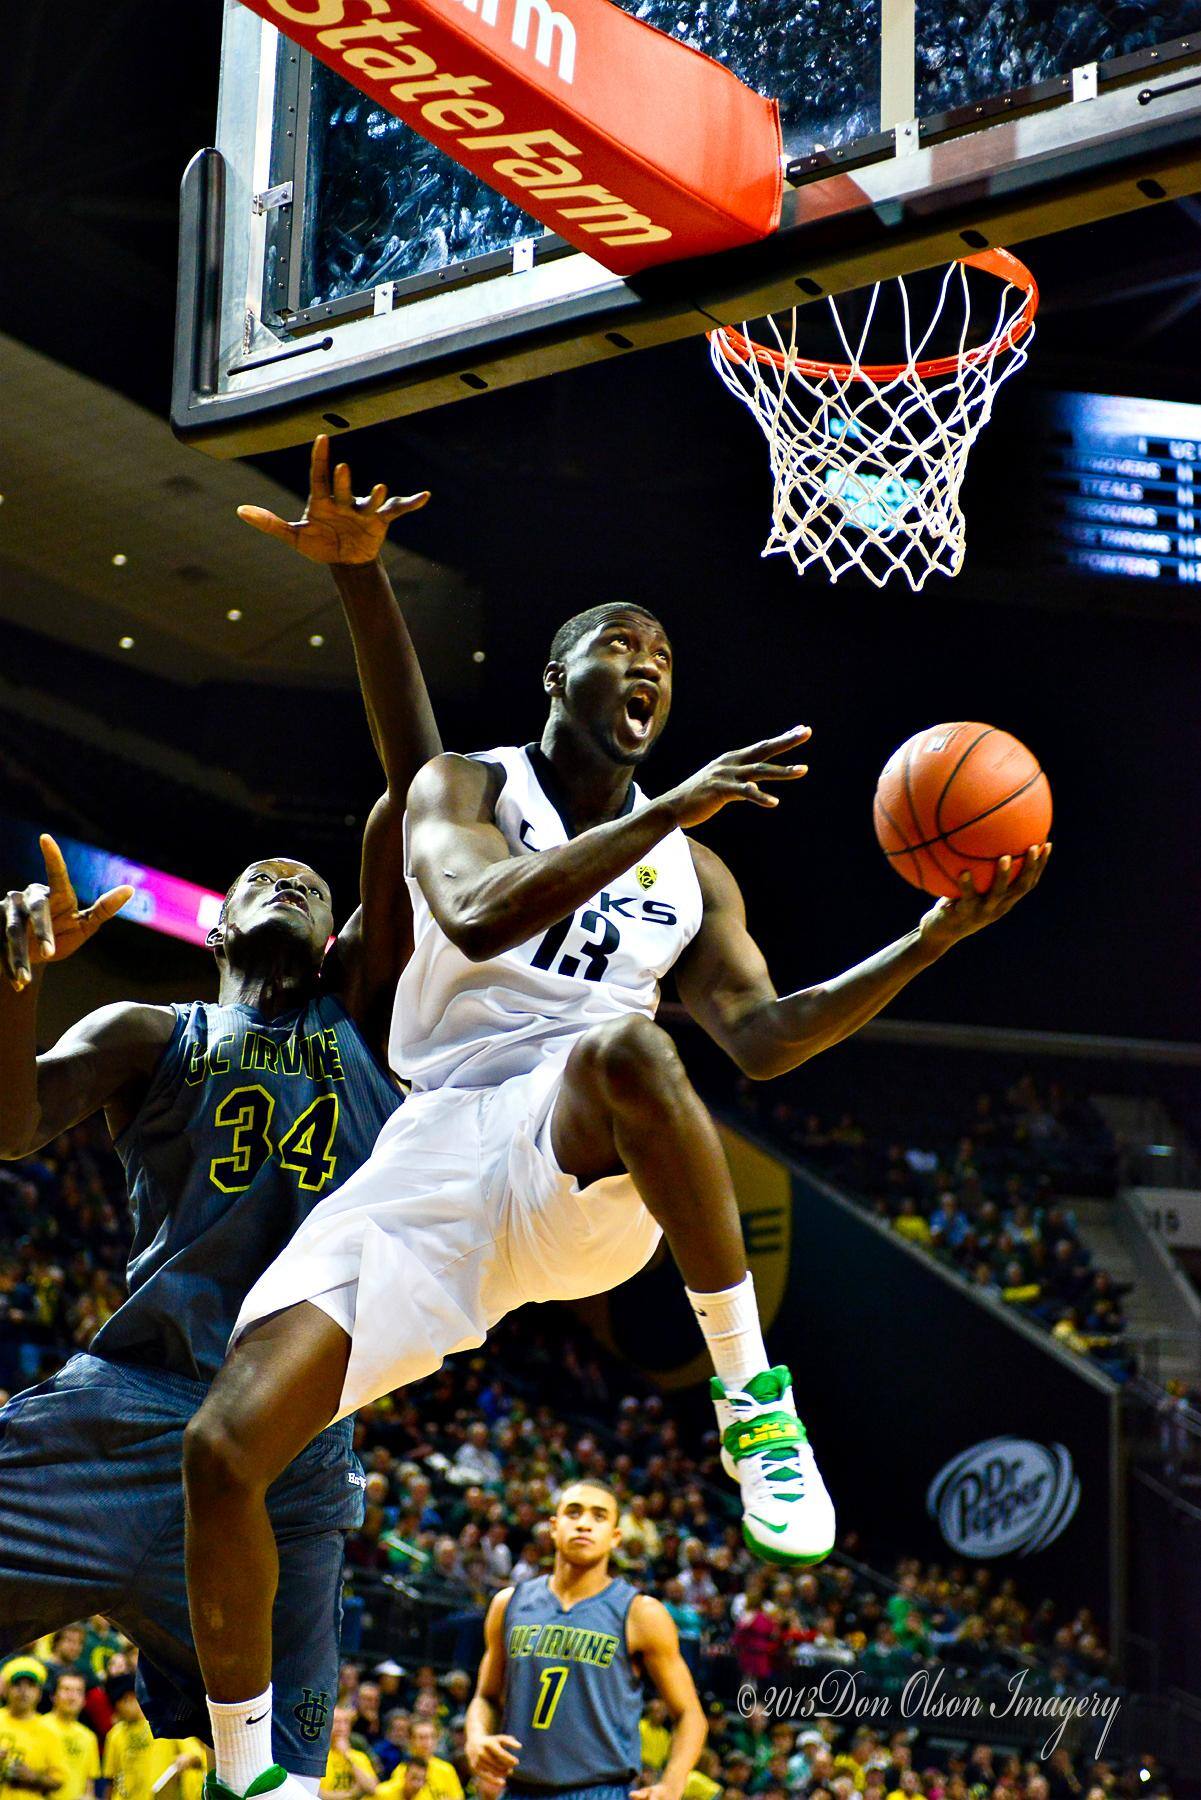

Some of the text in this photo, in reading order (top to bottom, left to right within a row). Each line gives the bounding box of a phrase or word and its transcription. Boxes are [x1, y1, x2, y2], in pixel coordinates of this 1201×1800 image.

[457, 128, 673, 247] Farm
[209, 1083, 340, 1193] 34
[534, 1624, 621, 1669] IRVINE
[532, 1666, 570, 1730] 1
